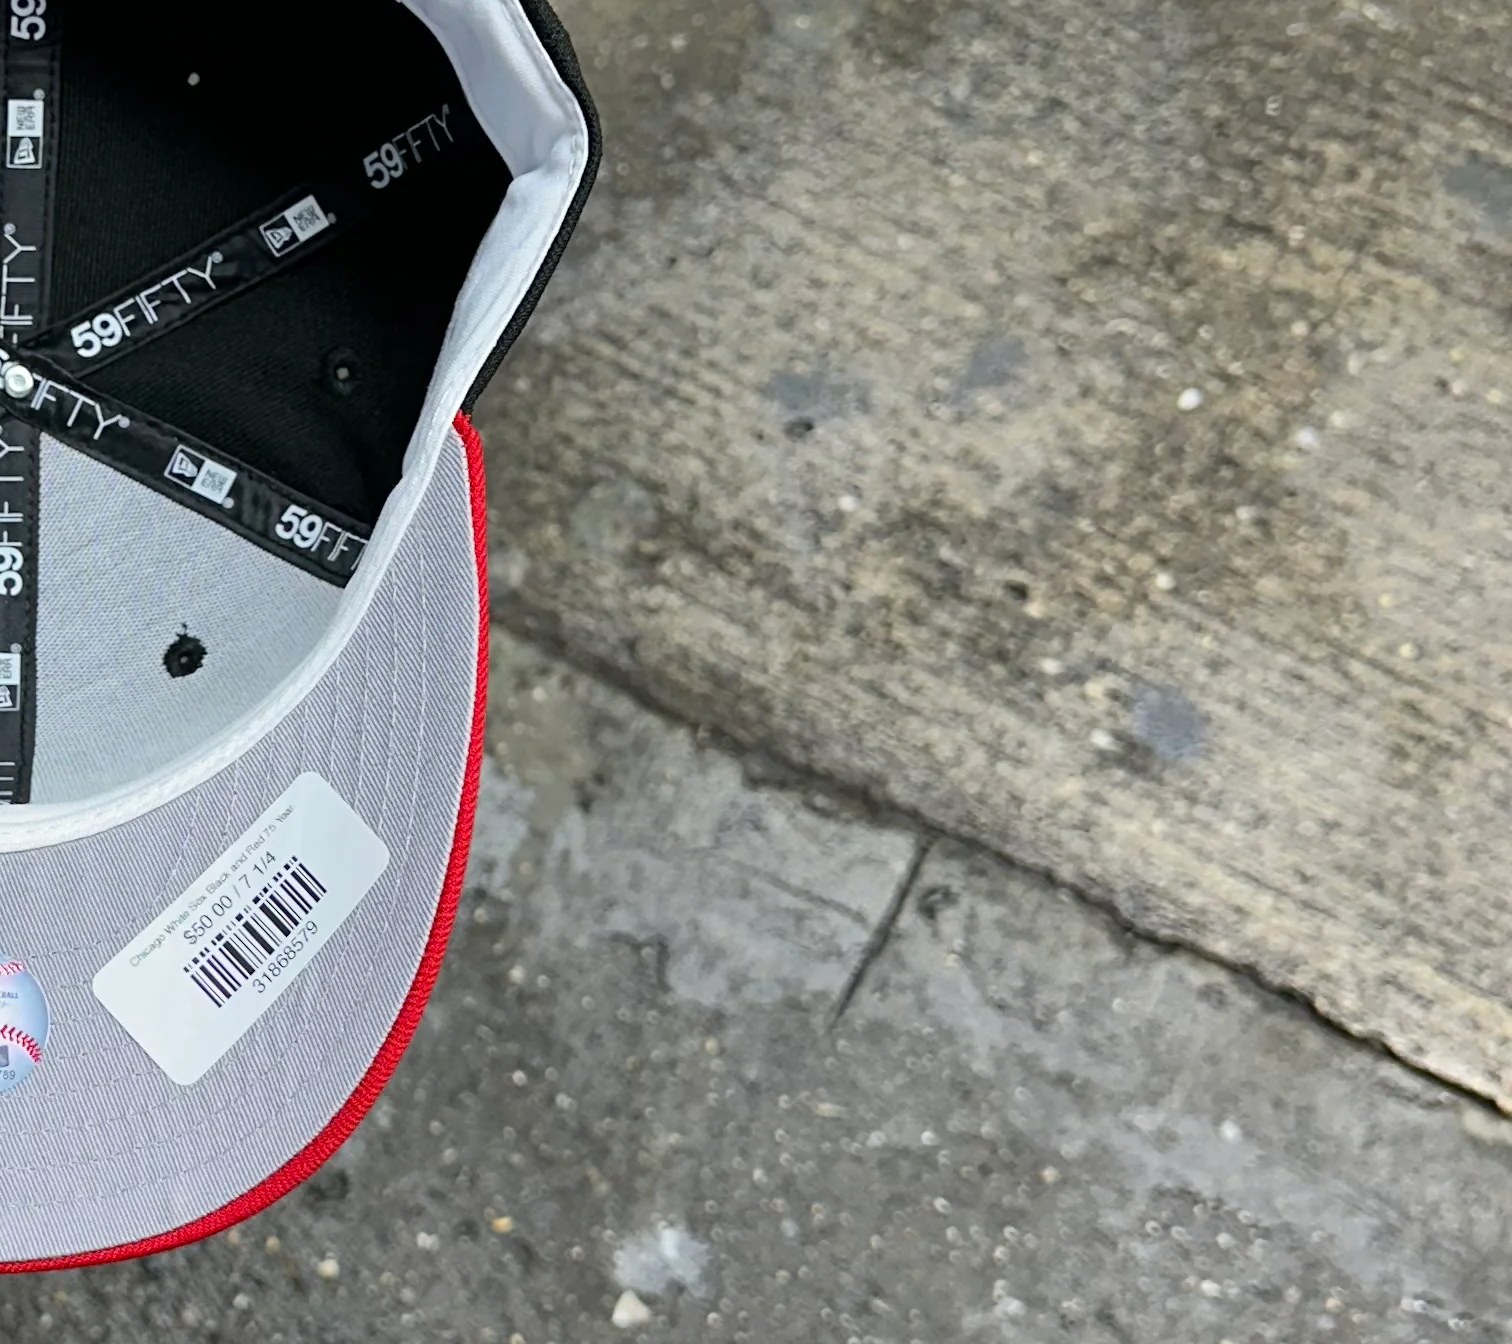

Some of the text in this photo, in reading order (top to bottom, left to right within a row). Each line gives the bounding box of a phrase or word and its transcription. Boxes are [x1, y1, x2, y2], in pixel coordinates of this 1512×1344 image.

[362, 112, 454, 189] 59FIFTY
[70, 256, 217, 357] 59FIFTY
[129, 934, 165, 967] Chicago
[163, 910, 190, 935] White
[189, 894, 207, 911] Sox
[206, 871, 230, 894] Black
[231, 852, 248, 872] and
[245, 835, 266, 855] Red
[262, 824, 277, 837] 75
[239, 873, 251, 889] 7
[253, 850, 276, 875] 1/4
[252, 920, 318, 994] 31868579
